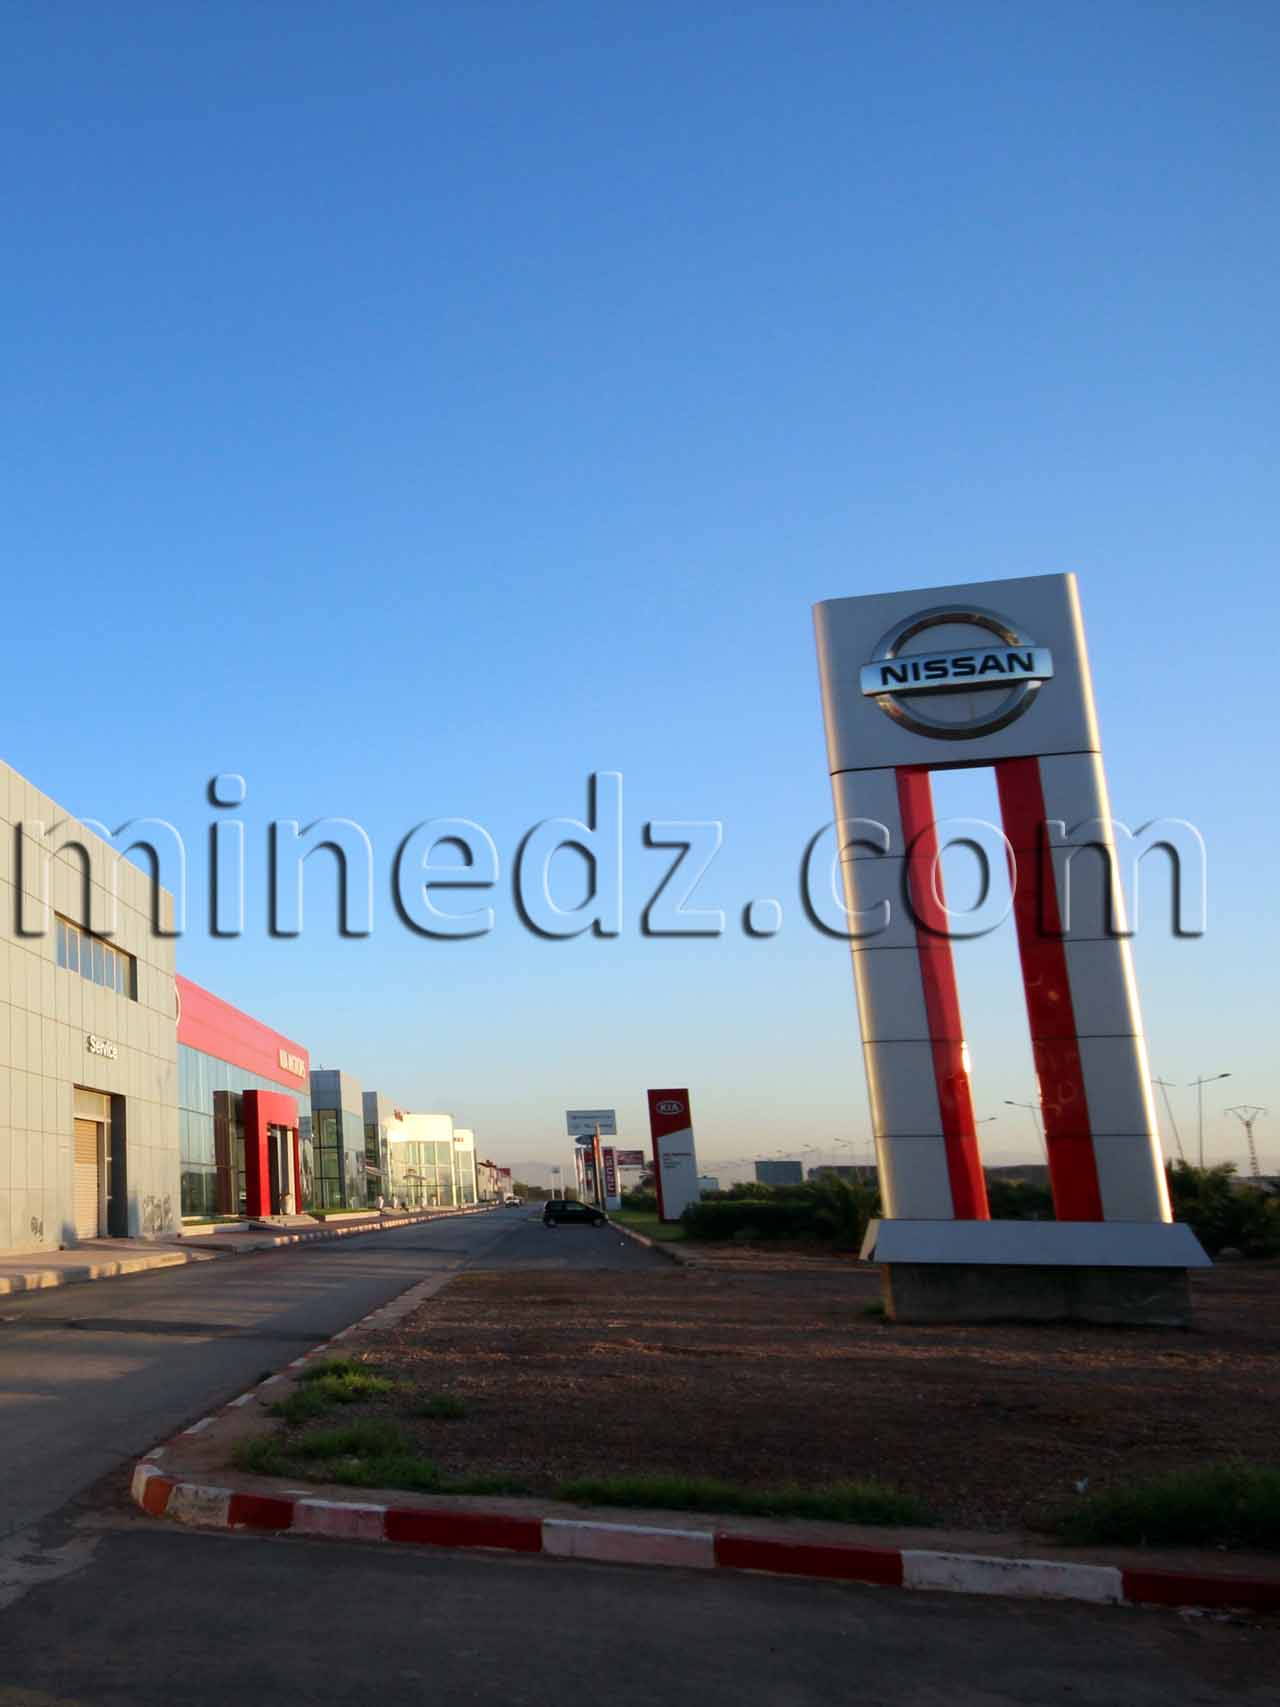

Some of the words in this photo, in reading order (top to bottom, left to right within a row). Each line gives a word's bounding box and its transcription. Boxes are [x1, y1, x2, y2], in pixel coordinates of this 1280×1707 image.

[880, 651, 1036, 686] NISSAN
[87, 1034, 119, 1061] Service
[659, 1103, 680, 1113] KIA
